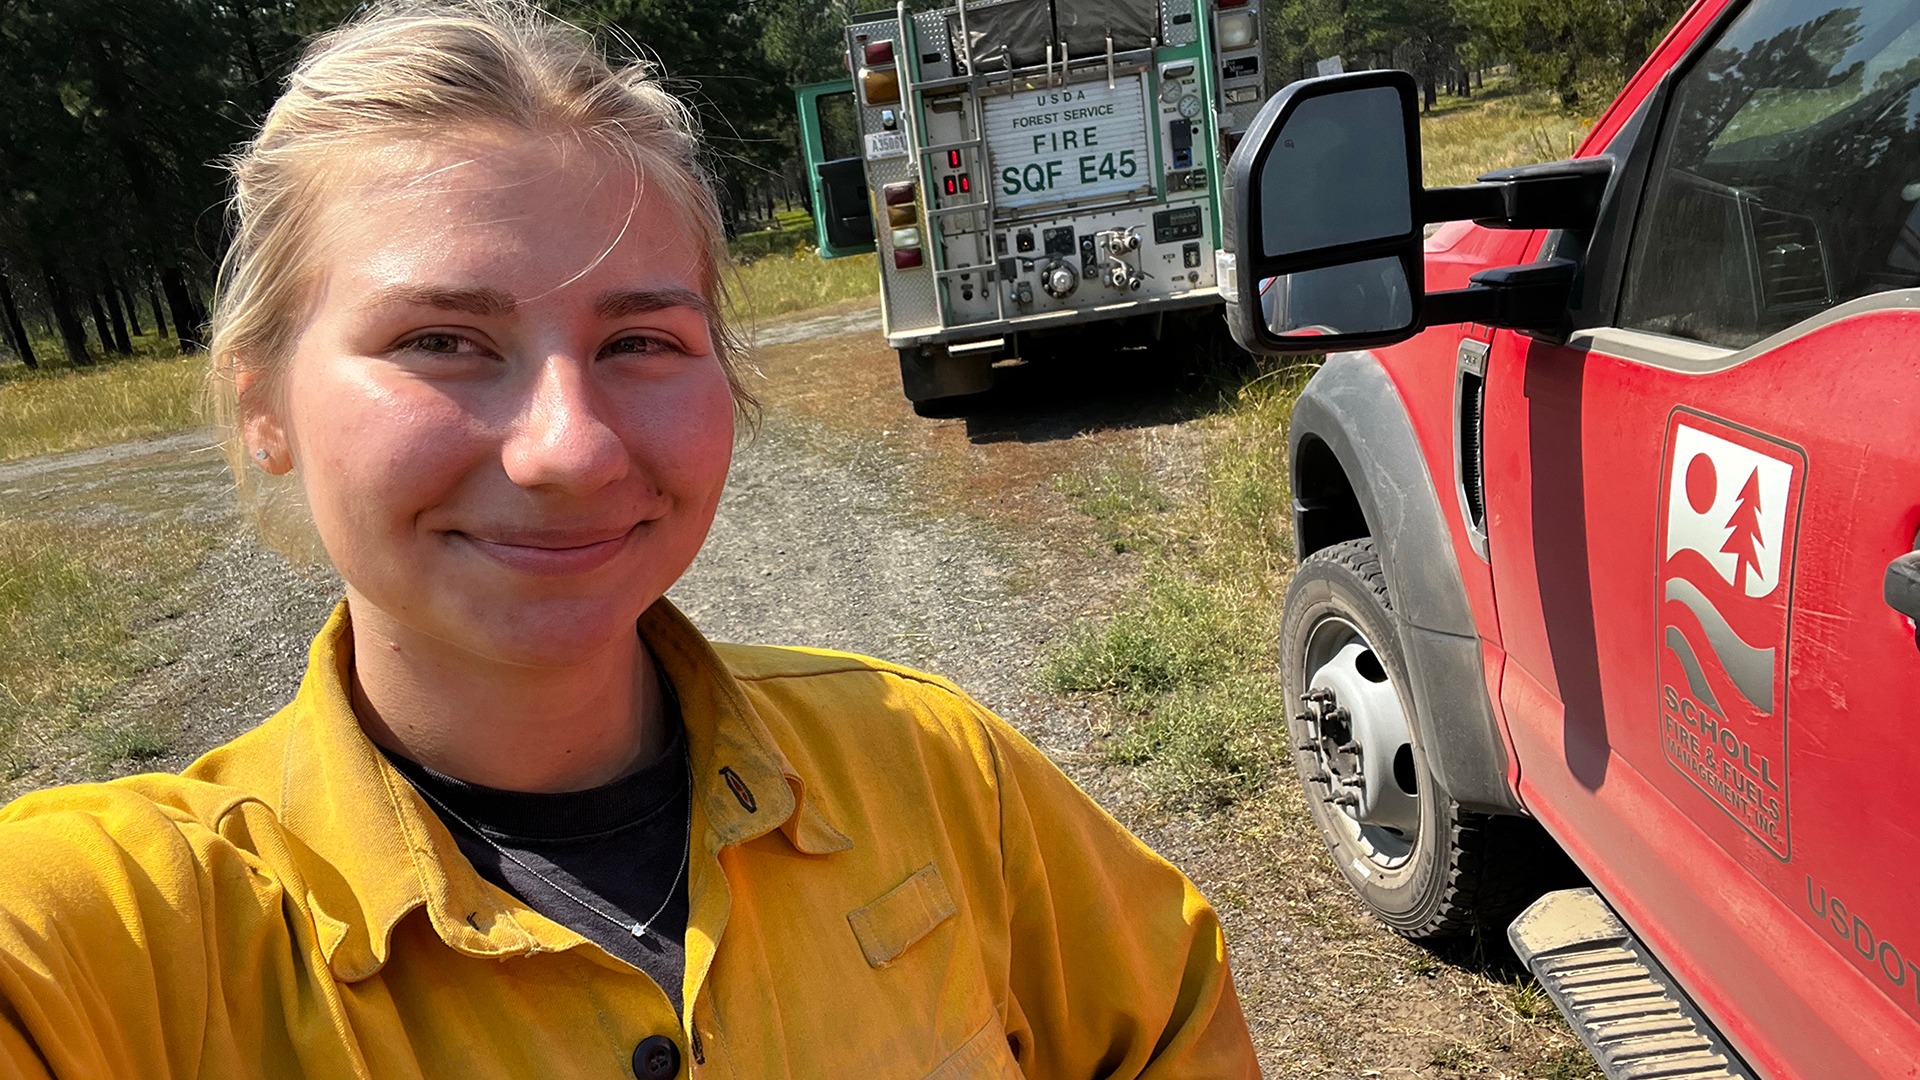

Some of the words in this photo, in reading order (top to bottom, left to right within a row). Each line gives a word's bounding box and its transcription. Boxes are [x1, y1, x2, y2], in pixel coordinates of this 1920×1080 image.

[1012, 112, 1059, 129] FOREST
[1063, 104, 1114, 122] SERVICE
[1037, 90, 1086, 107] USDA
[1032, 126, 1098, 154] FIRE
[1002, 160, 1063, 196] SQF
[1079, 149, 1137, 185] E45
[1663, 684, 1779, 793] SCHOLL
[1665, 714, 1701, 758] FIRE
[1705, 745, 1717, 771] &
[1722, 758, 1781, 822] FUELS
[1805, 873, 1920, 1006] USDOT
